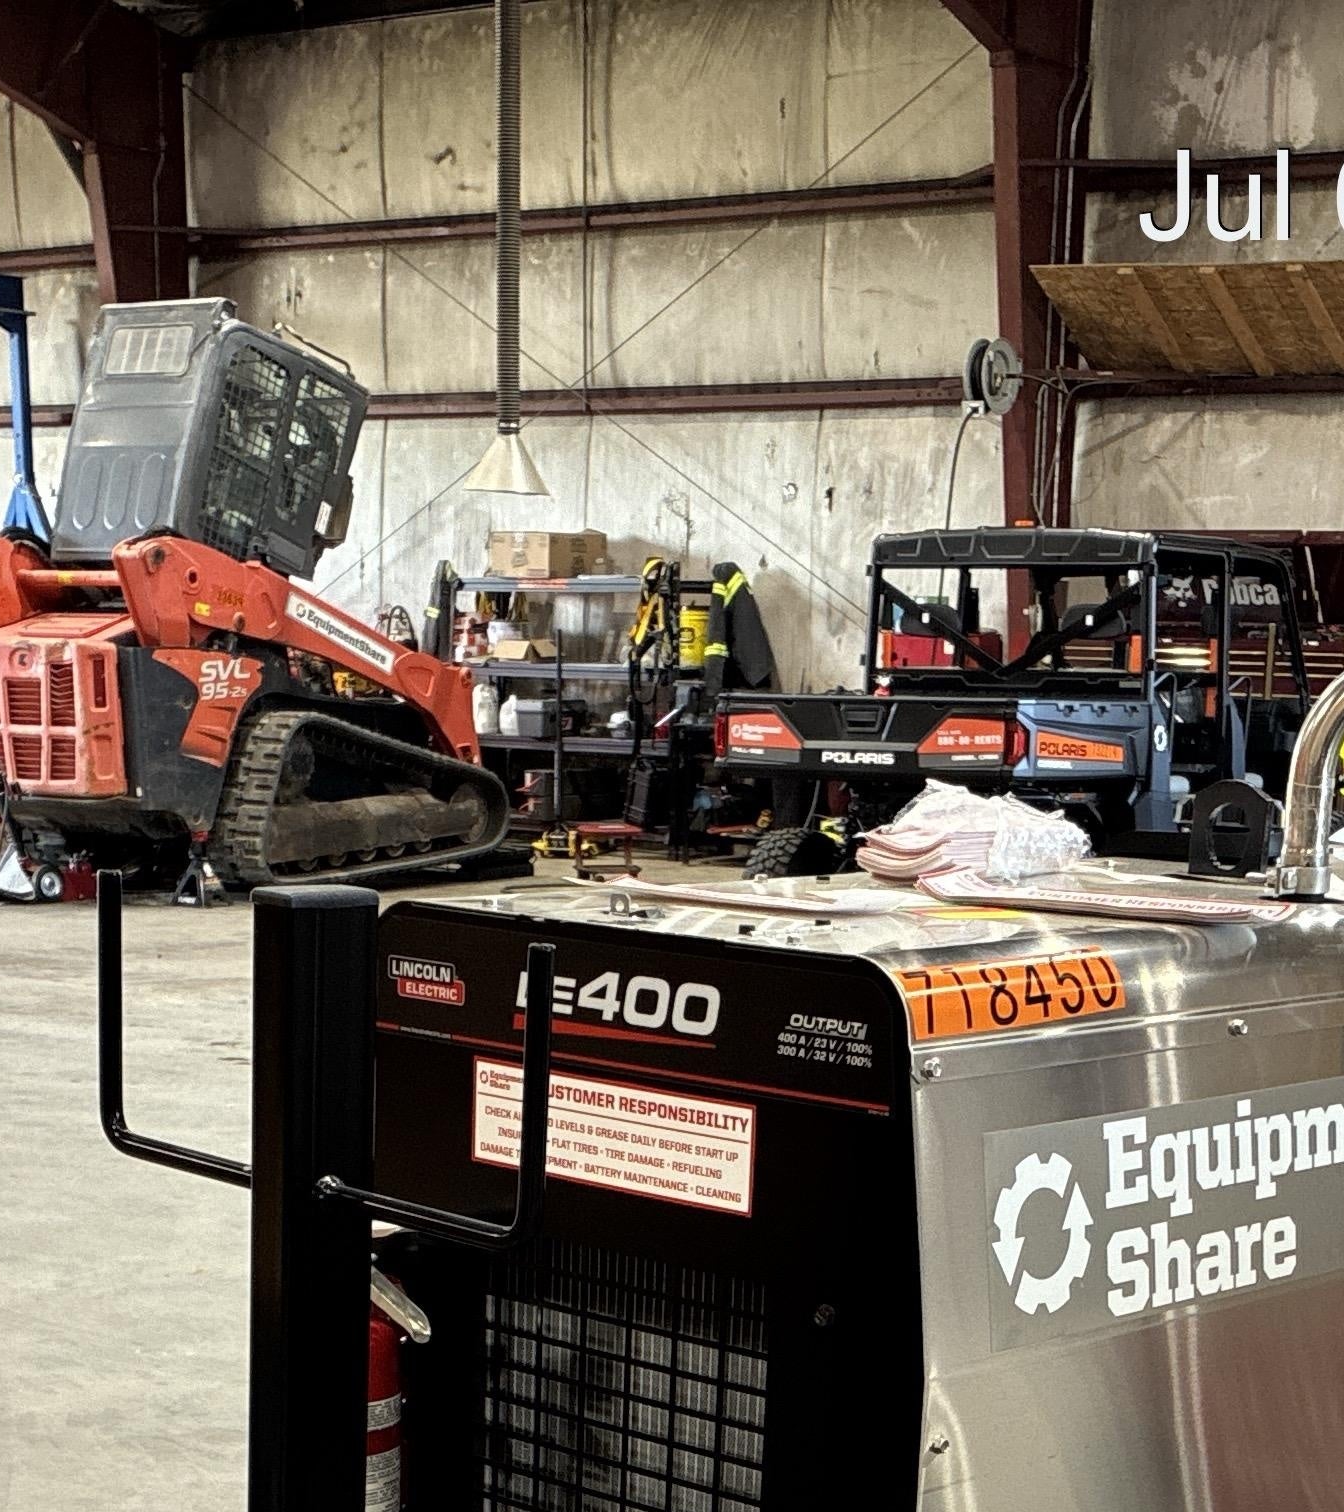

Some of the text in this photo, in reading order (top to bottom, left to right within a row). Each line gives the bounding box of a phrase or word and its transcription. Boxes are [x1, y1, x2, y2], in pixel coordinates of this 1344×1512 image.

[306, 609, 388, 666] EquipmentShare
[199, 657, 251, 684] SVL
[821, 751, 895, 765] POLARIS
[1039, 741, 1088, 757] POLARIS
[391, 959, 451, 983] LINCOLN
[405, 981, 458, 1001] ELECTRIC
[789, 1013, 863, 1036] OUTPUT
[777, 1032, 797, 1044] 400
[846, 1042, 873, 1055] 100%
[777, 1045, 796, 1057] 300
[813, 1050, 827, 1061] 32
[845, 1054, 873, 1068] 100%
[485, 1105, 512, 1120] CHECK
[548, 1083, 750, 1133] USTOMER RESPONSIBILITY
[555, 1119, 586, 1135] LEVELS
[595, 1126, 629, 1142] GREASE
[631, 1133, 657, 1147] DAILY
[659, 1139, 693, 1155] BEFORE
[695, 1145, 723, 1161] START
[725, 1151, 739, 1162] UP
[552, 1138, 722, 1180] FLAT TIRES TIRE DAMAGE REFUELING
[480, 1141, 515, 1158] DAMAGE
[584, 1163, 622, 1180] BATTERY
[623, 1171, 689, 1193] MAINTENANCE
[695, 1185, 742, 1203] CLEANING
[1106, 1216, 1297, 1317] Share
